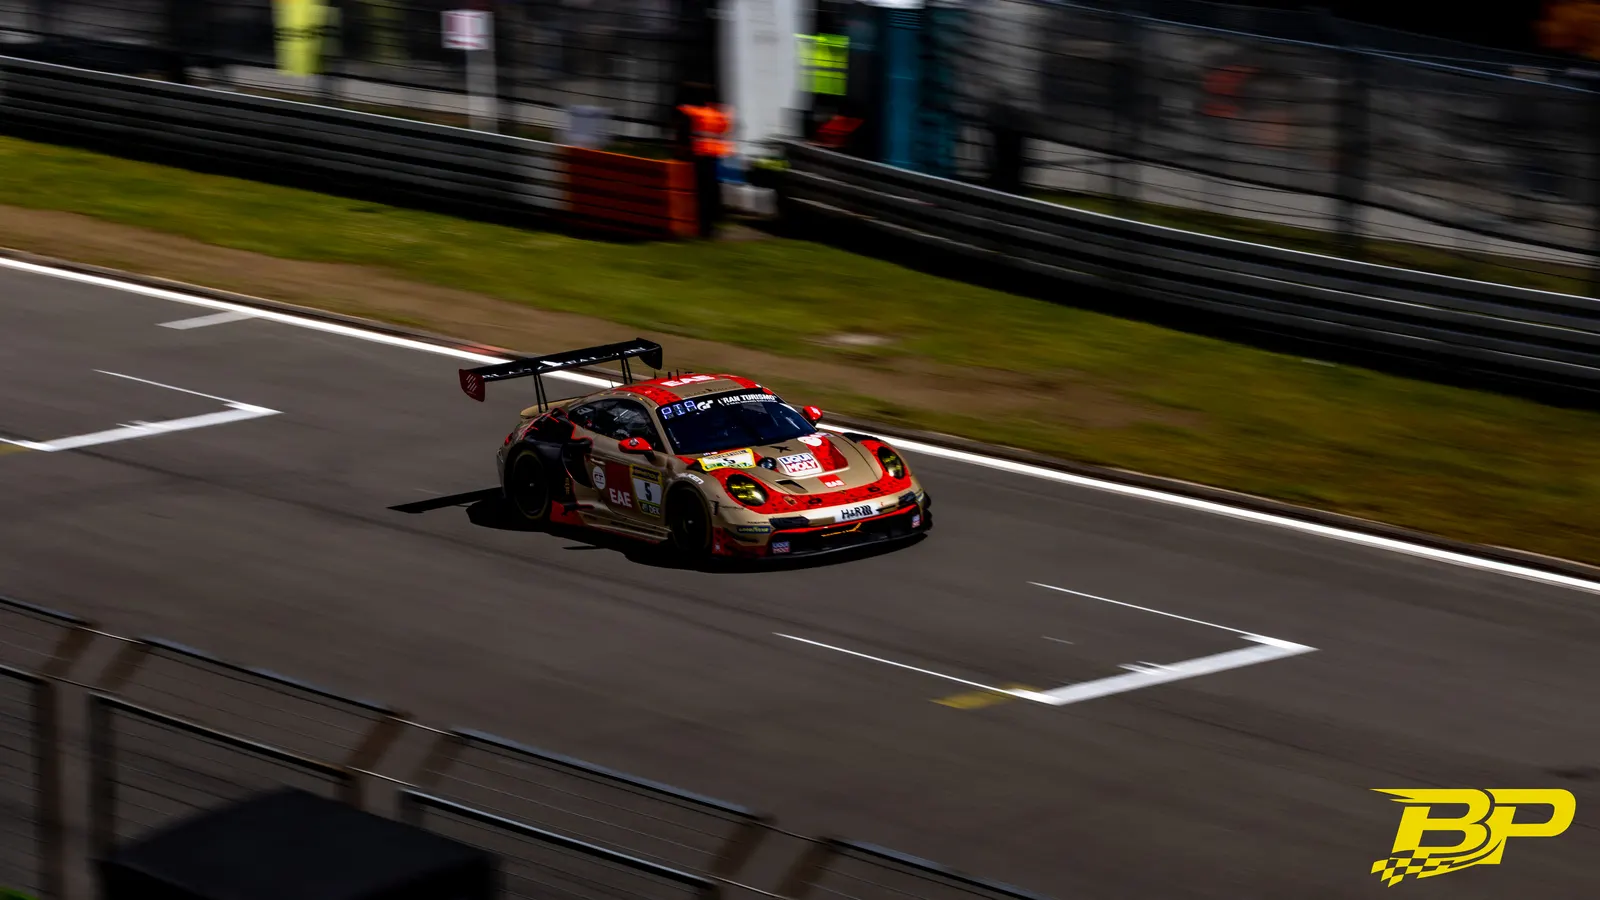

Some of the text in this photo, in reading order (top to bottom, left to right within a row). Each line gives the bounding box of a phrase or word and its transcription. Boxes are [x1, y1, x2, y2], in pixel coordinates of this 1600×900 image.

[740, 393, 777, 401] TURISMO
[779, 453, 813, 465] LIQUI
[786, 460, 818, 473] MOLY
[608, 487, 633, 508] EAE
[644, 482, 652, 501] 5
